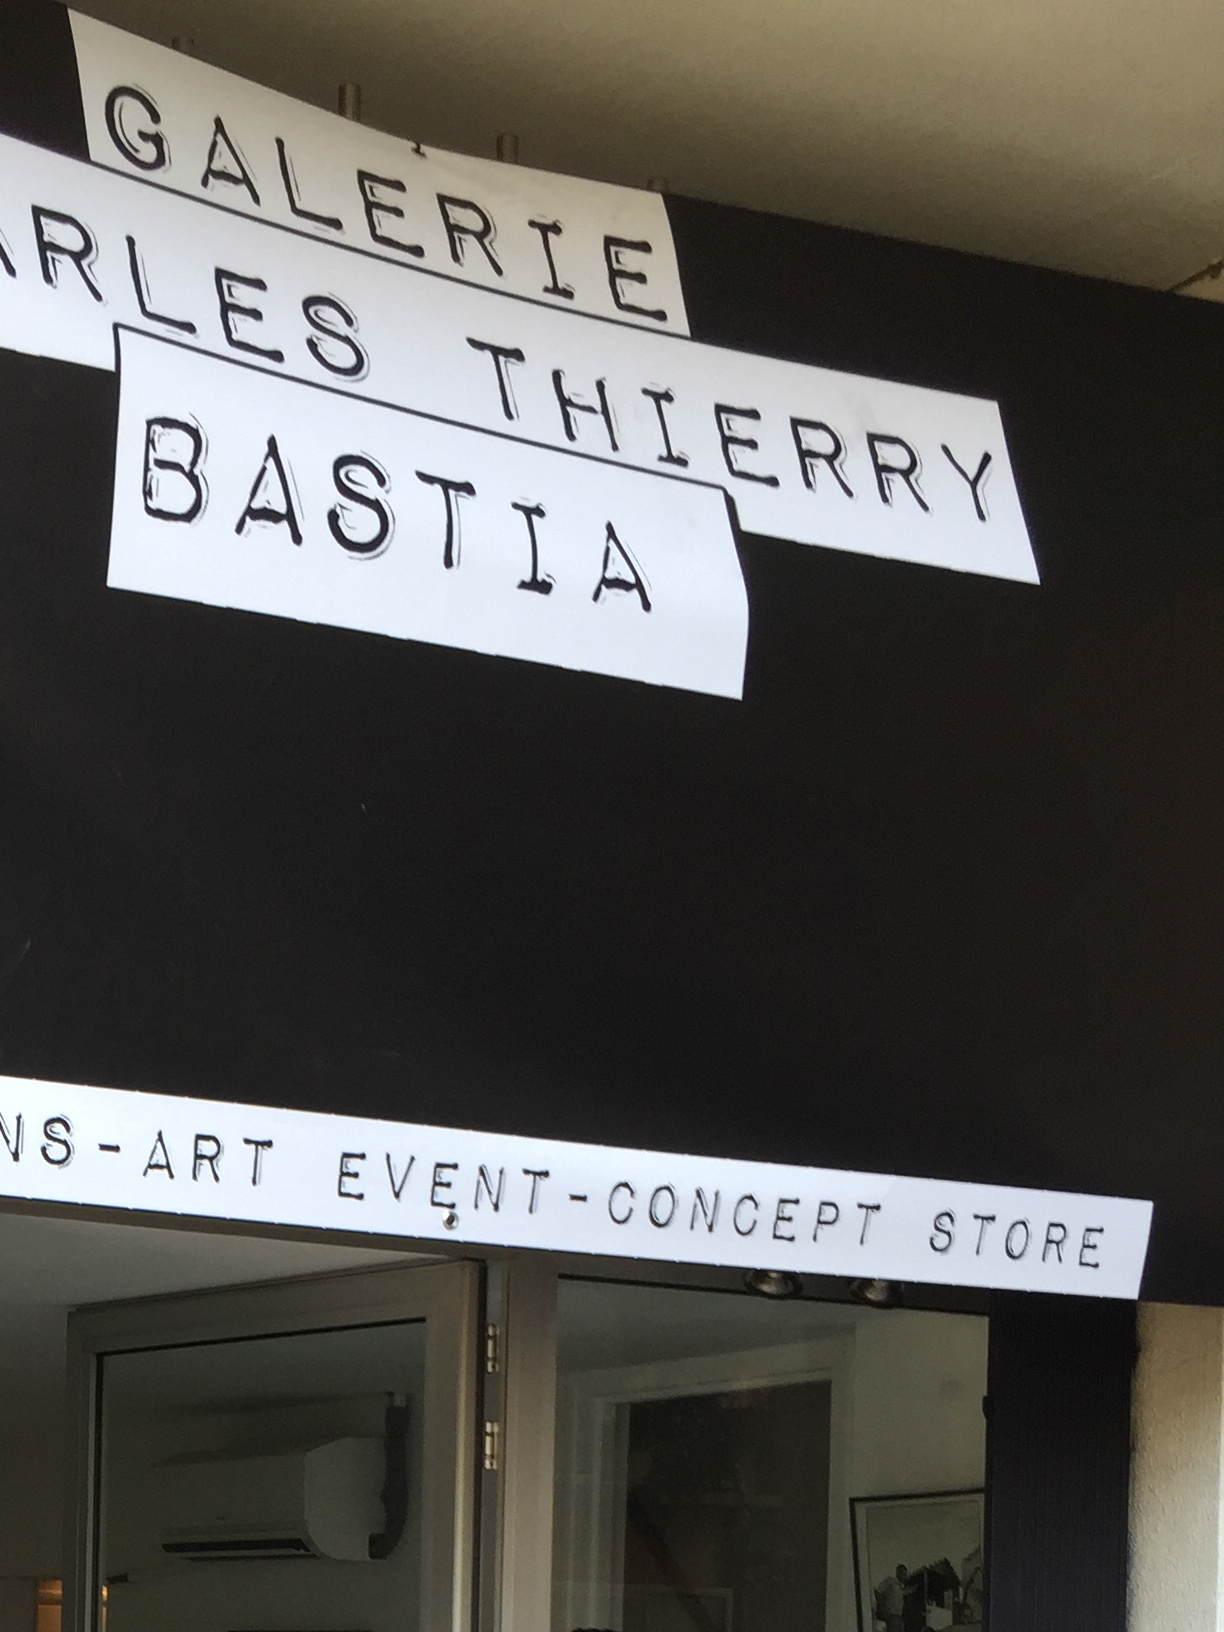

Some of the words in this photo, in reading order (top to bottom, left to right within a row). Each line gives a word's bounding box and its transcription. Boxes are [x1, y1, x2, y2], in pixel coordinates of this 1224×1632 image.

[104, 84, 668, 323] GALERIE
[141, 414, 653, 614] BASTIA
[466, 336, 993, 522] THIERRY
[928, 1208, 1107, 1271] STORE
